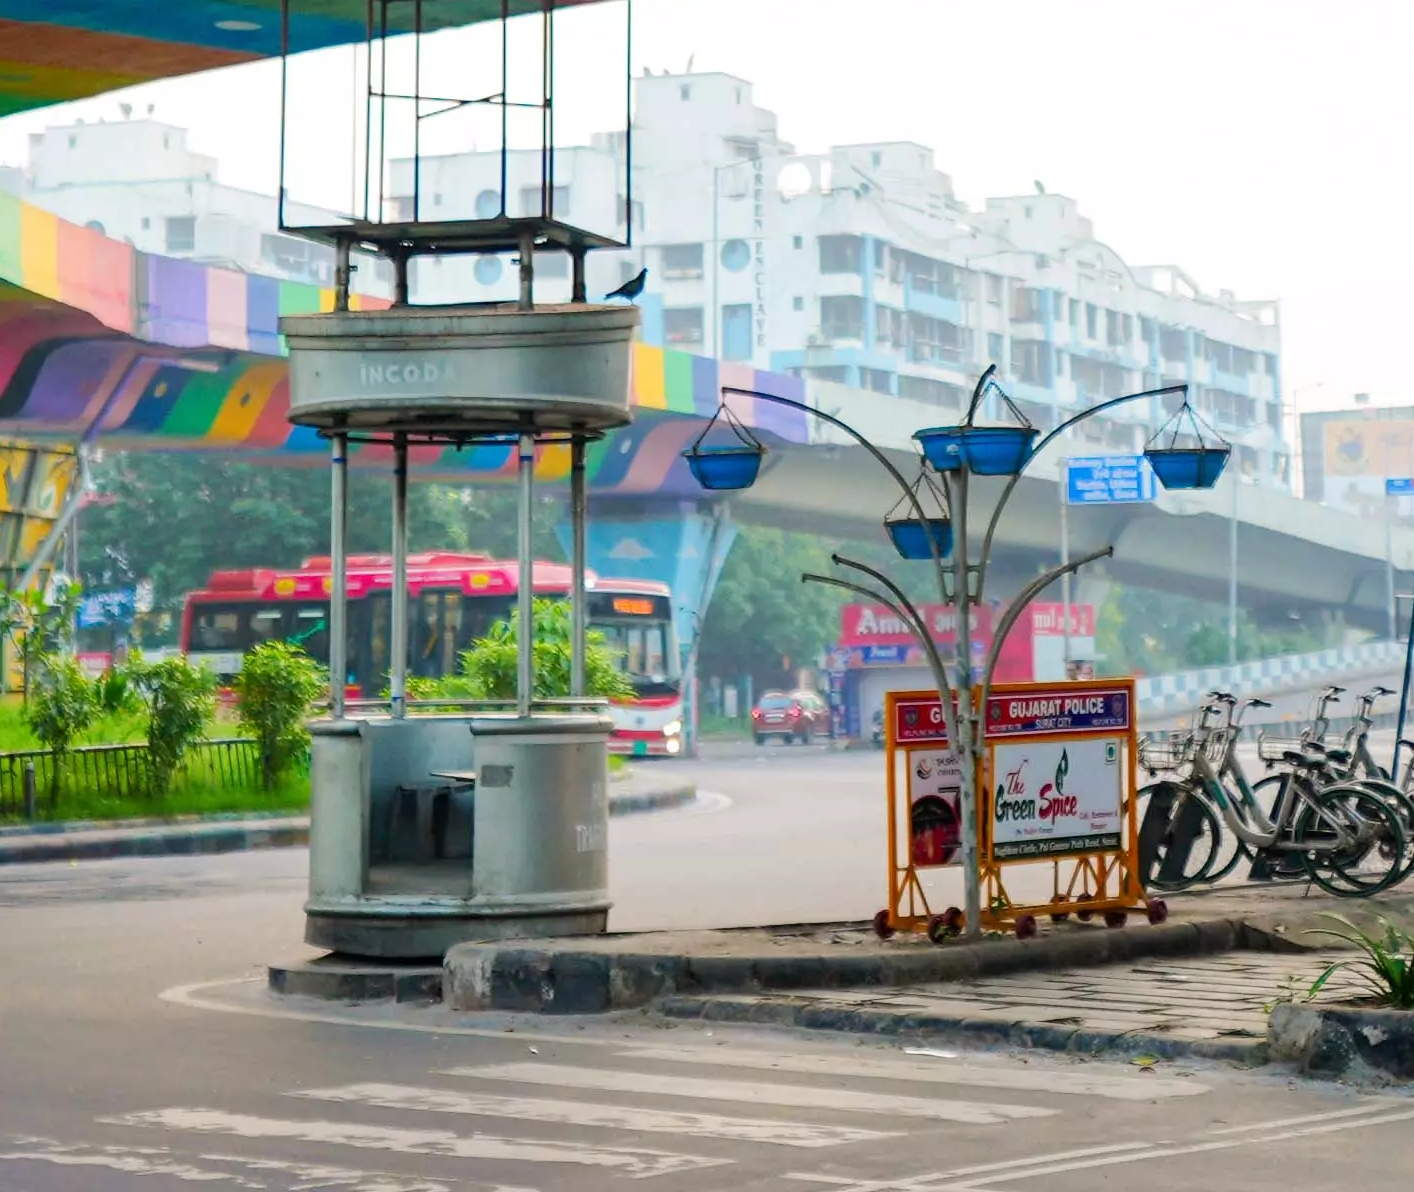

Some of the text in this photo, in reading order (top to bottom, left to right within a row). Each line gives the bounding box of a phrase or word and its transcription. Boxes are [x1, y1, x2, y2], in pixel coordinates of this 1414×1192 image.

[753, 160, 767, 348] GREEN ENCLAVE
[1009, 697, 1105, 719] GUJARAT POLICE
[1035, 718, 1057, 729] SURAT
[1058, 717, 1072, 728] CITY
[994, 783, 1077, 826] Green Spice
